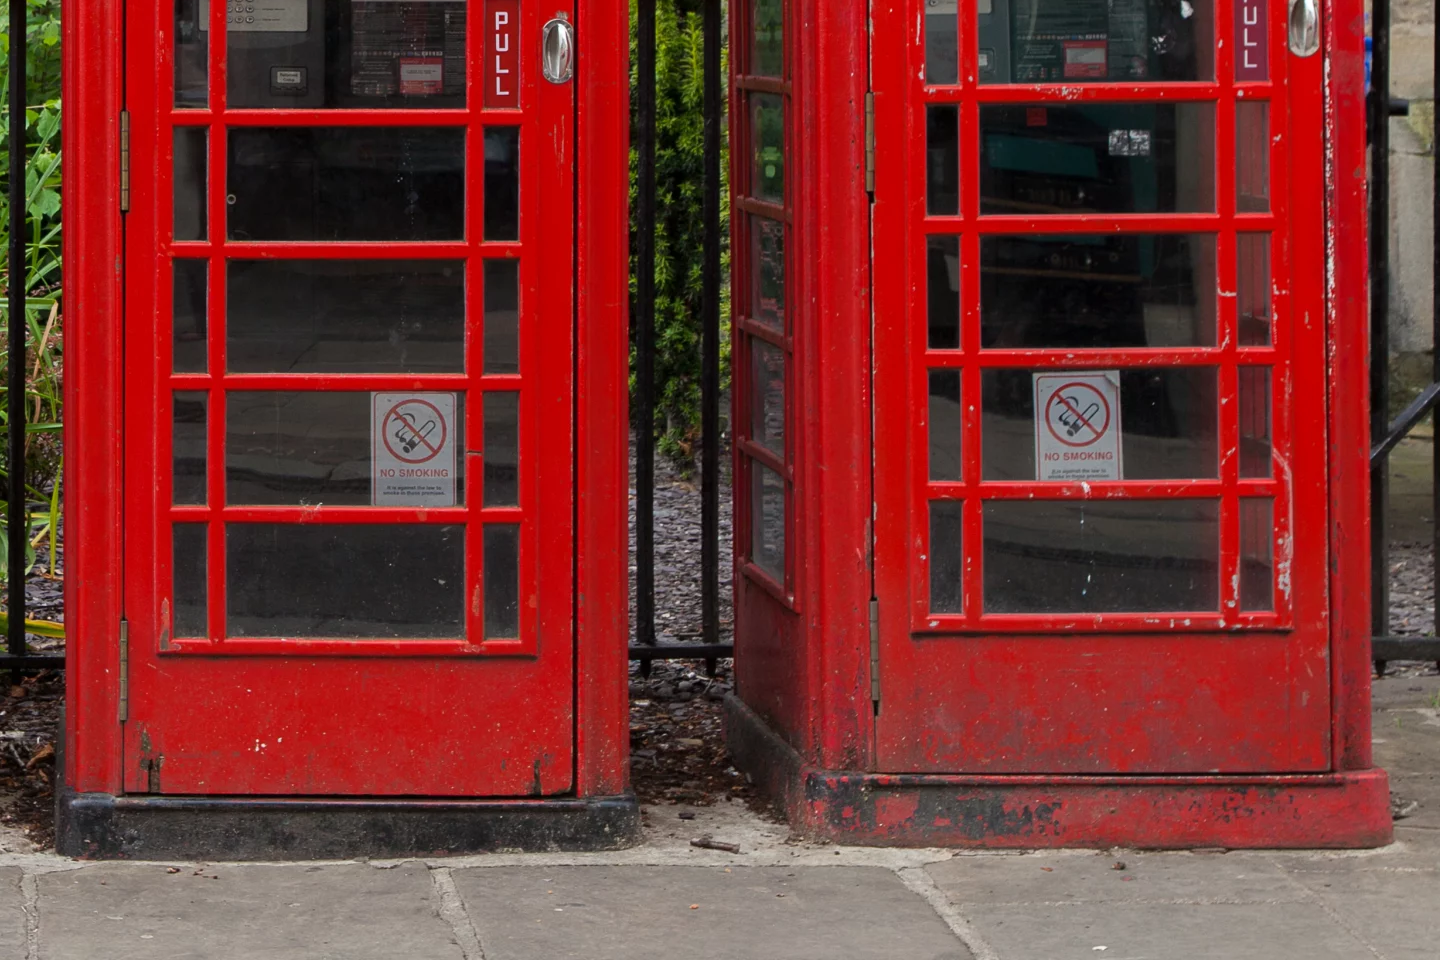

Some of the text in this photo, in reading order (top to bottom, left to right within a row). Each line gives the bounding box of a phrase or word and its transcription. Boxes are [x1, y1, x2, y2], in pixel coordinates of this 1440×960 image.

[495, 11, 509, 96] PULL
[1044, 451, 1114, 461] NO SMOKING
[380, 468, 449, 478] NO SMOKING
